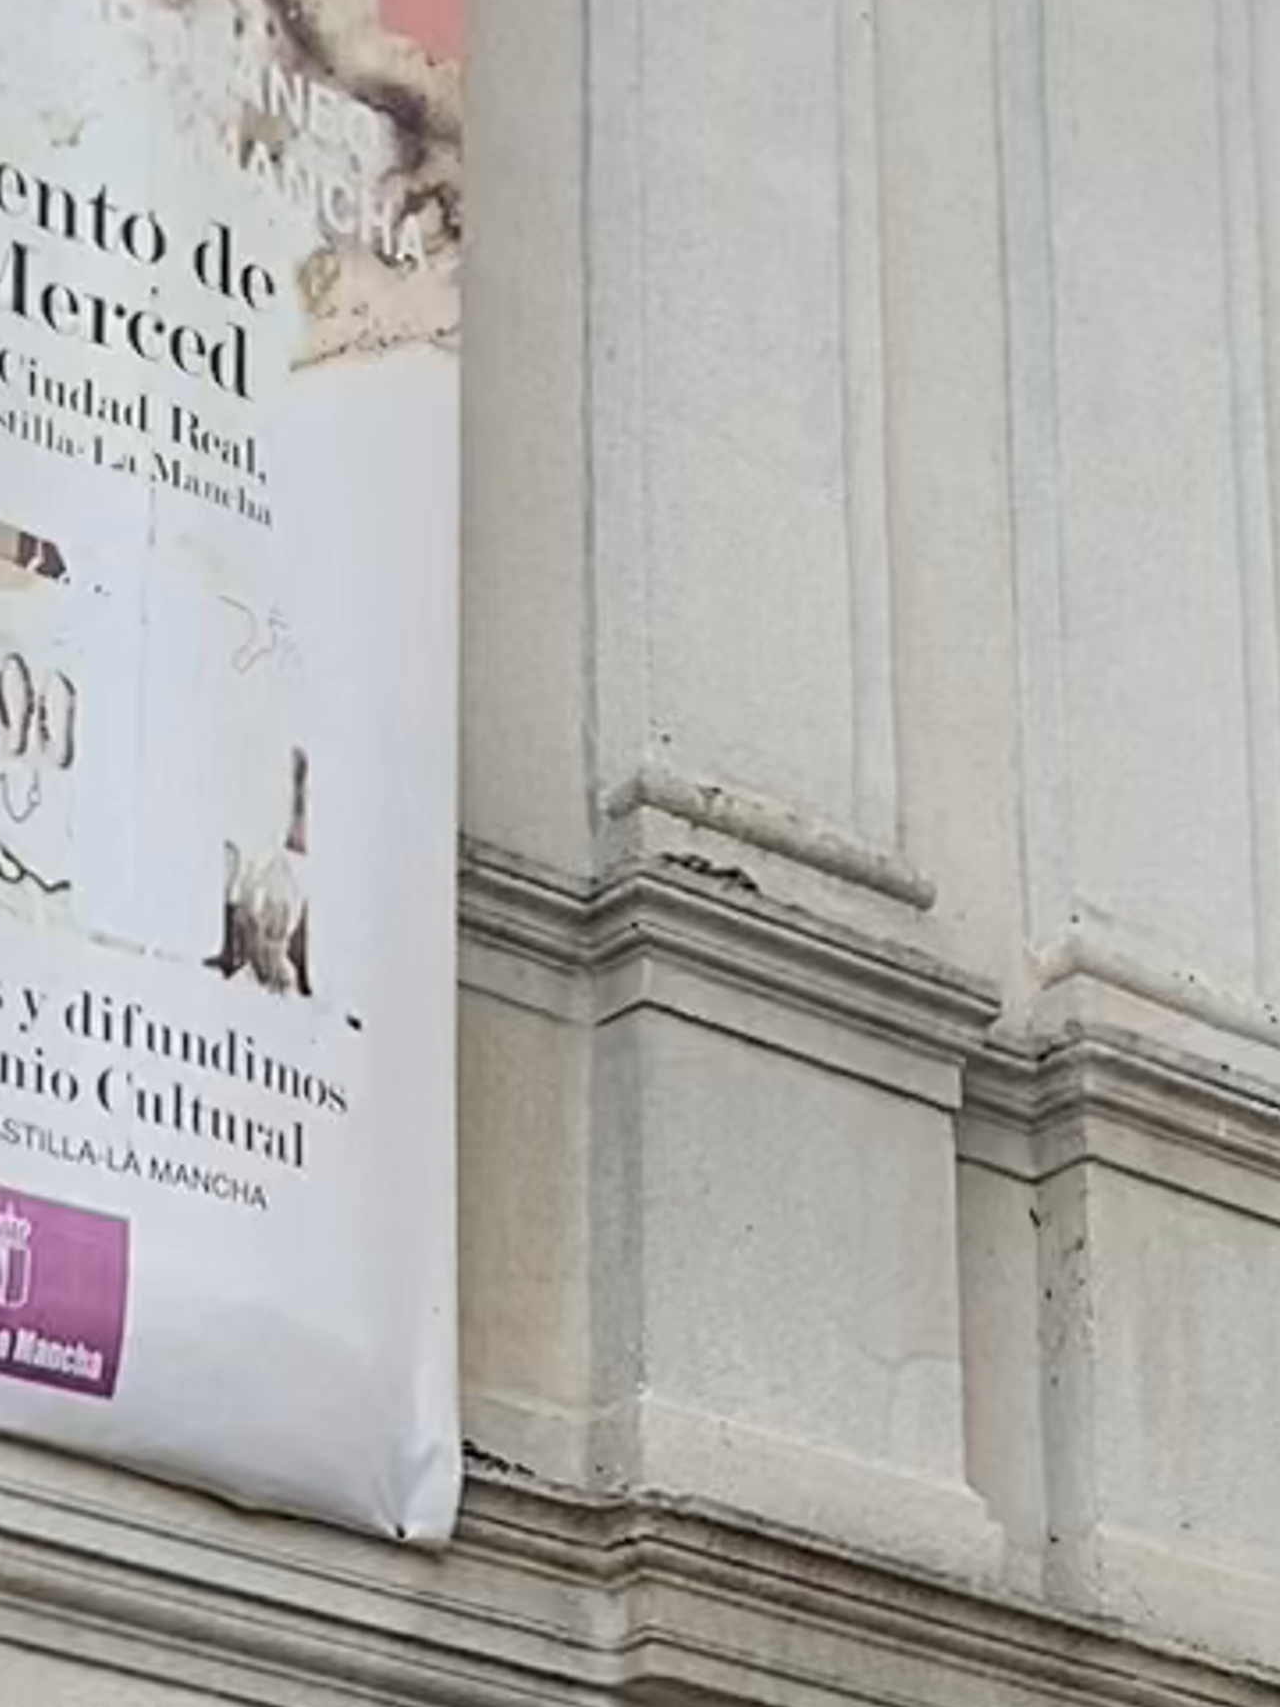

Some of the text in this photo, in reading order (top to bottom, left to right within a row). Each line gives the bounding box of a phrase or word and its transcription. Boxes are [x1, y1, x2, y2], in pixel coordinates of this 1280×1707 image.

[193, 220, 275, 311] de
[172, 405, 267, 485] Real,
[150, 452, 272, 526] Mancha
[19, 989, 46, 1033] y
[65, 990, 348, 1114] difundimos
[97, 1066, 303, 1169] Cultural
[150, 1156, 268, 1210] MANCHA
[12, 1327, 104, 1381] Mancha
